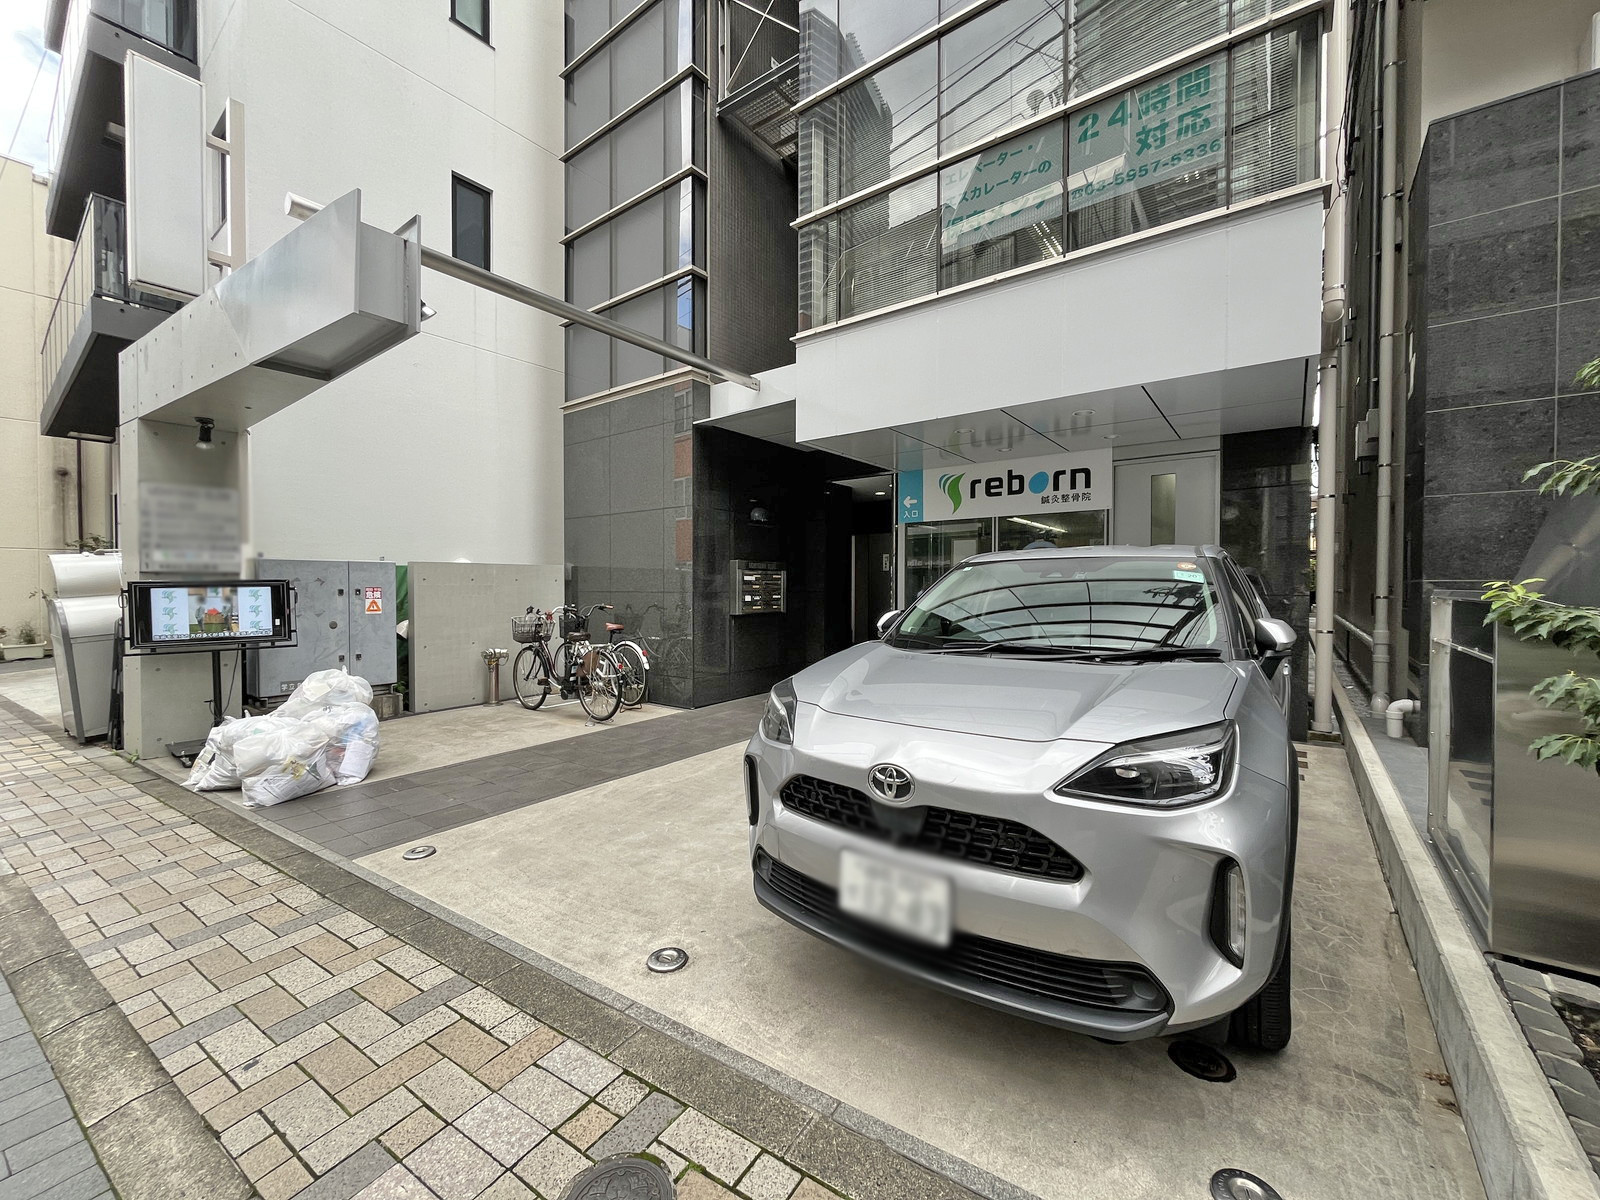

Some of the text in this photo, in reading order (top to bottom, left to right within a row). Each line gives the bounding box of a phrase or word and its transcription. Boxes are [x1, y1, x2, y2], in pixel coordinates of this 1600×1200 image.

[1078, 64, 1211, 144] 24時間
[1135, 103, 1211, 156] 対応
[970, 467, 1092, 499] reborn
[1041, 492, 1091, 505] 鍼灸整骨院
[903, 510, 918, 518] 入口
